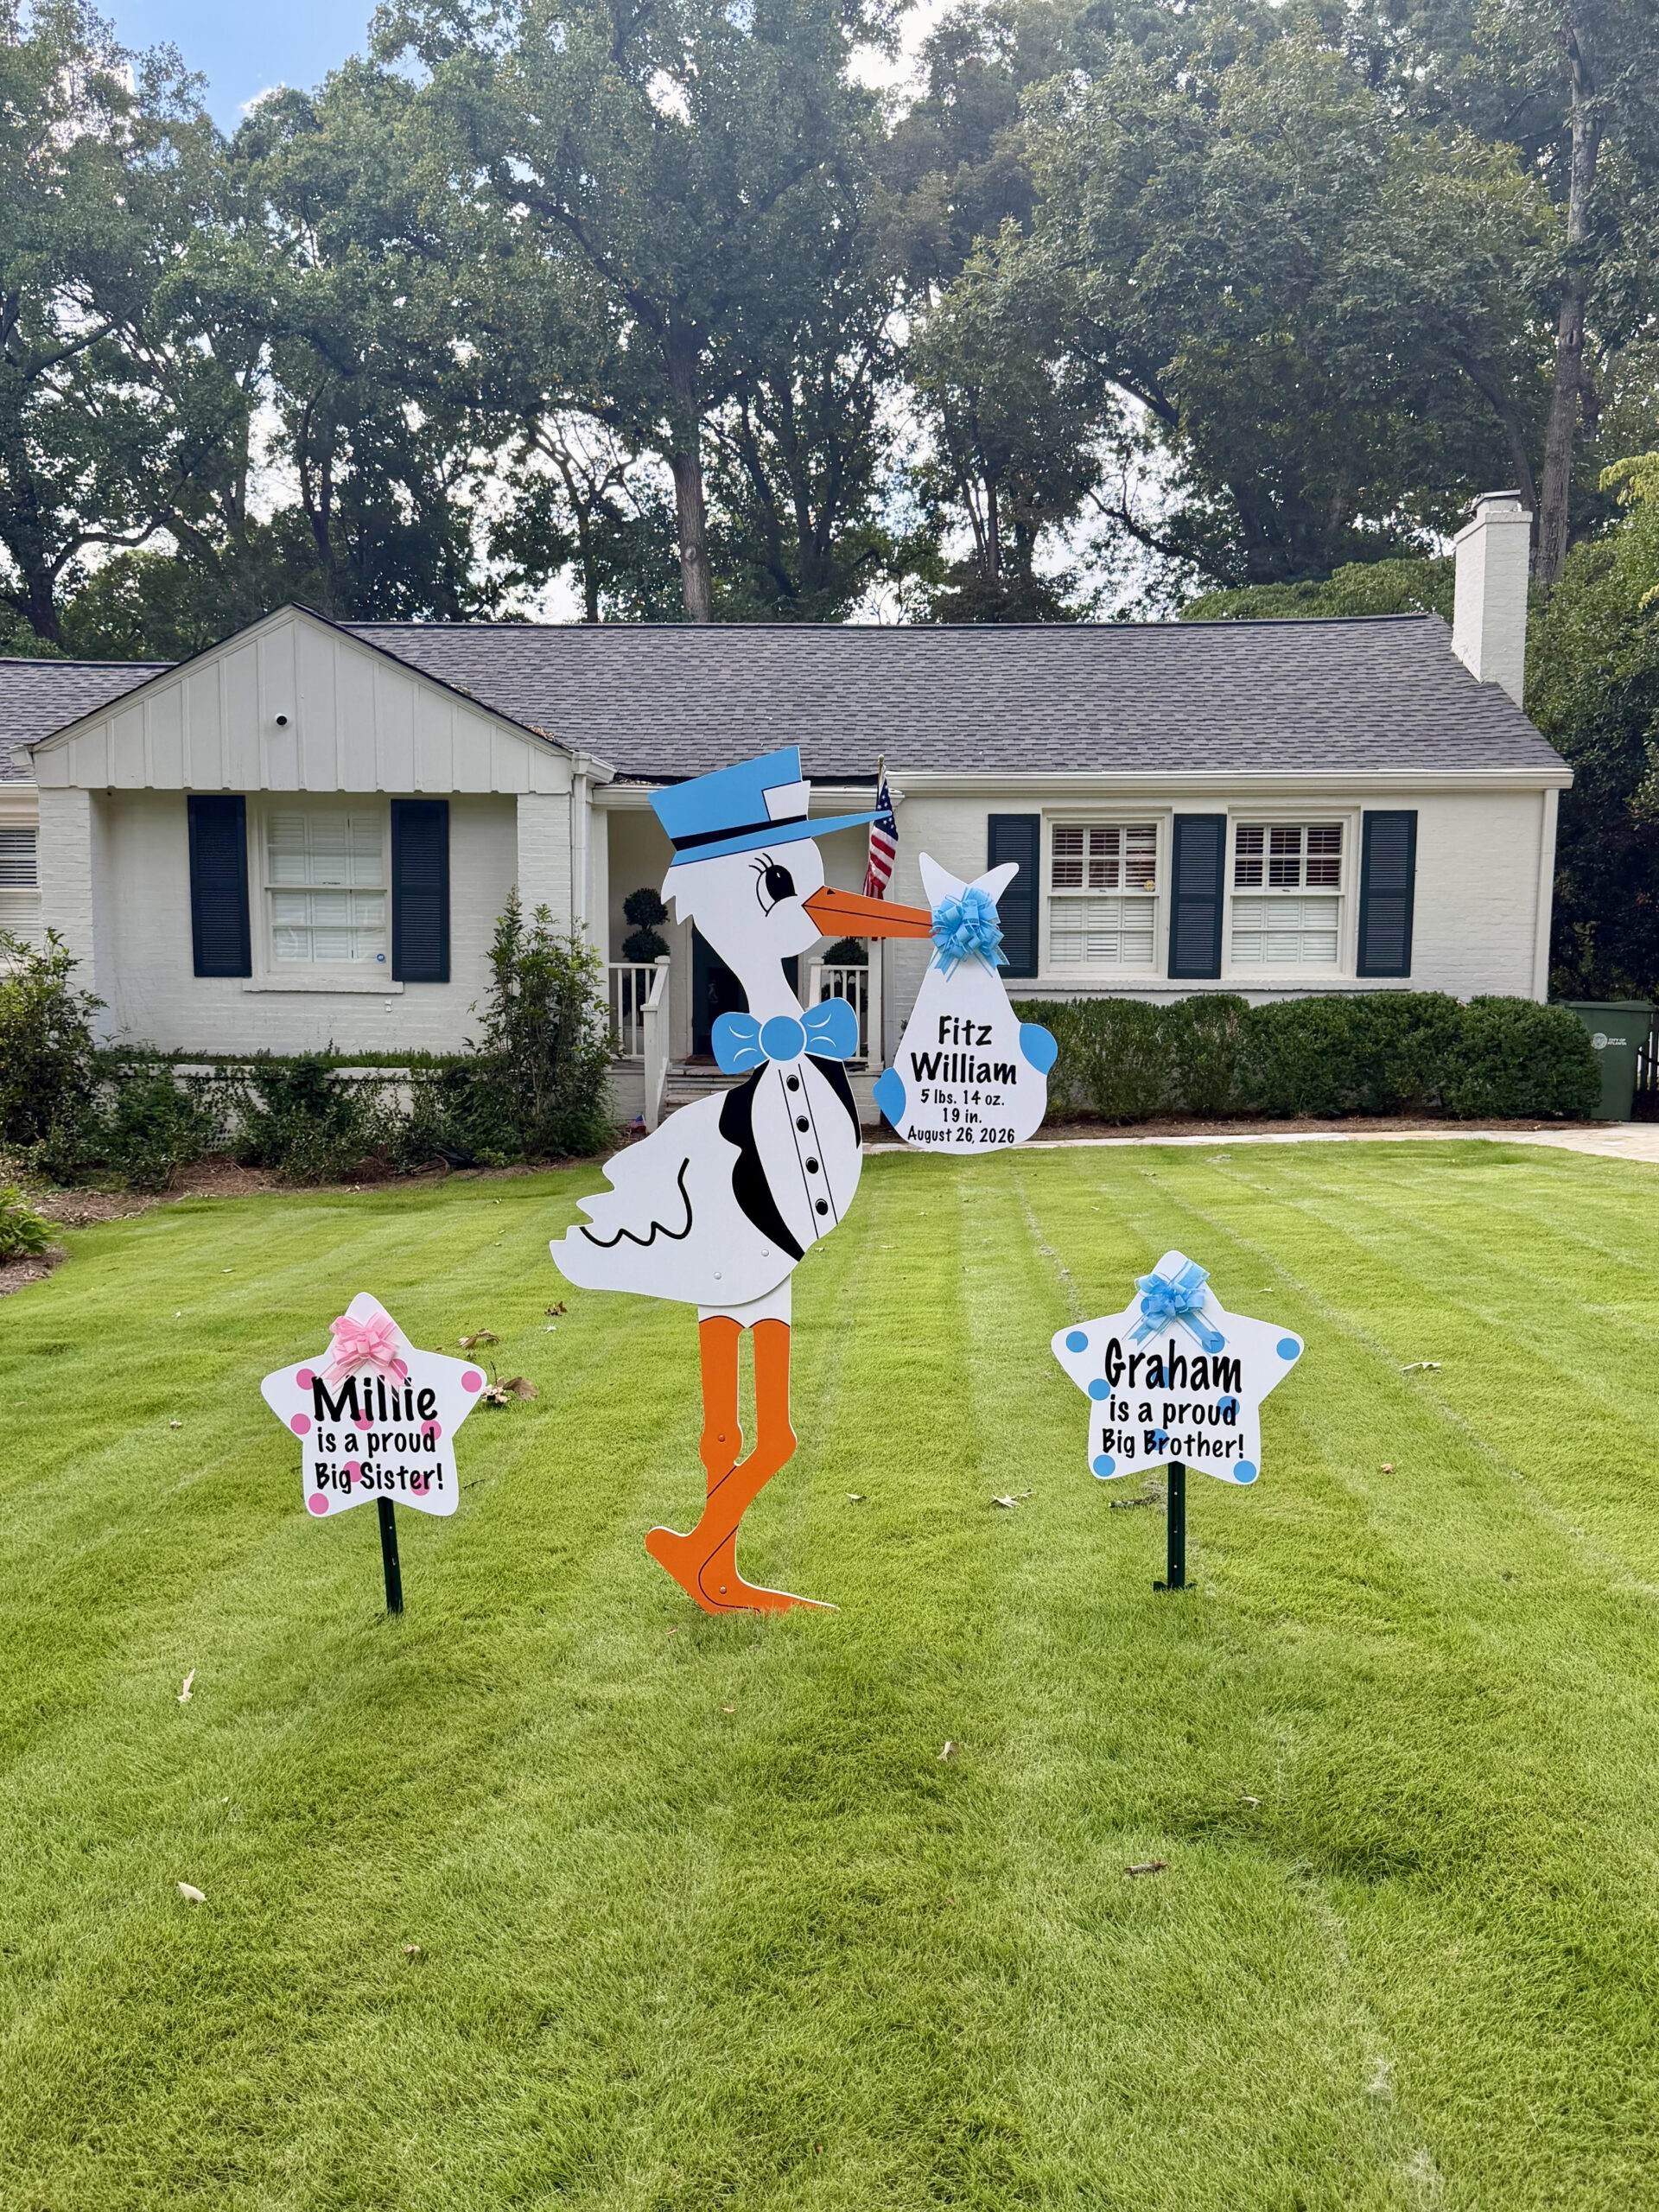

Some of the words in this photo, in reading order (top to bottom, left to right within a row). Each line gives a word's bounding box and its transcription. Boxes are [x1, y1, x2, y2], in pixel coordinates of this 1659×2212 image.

[938, 1014, 993, 1046] Fitz
[910, 1052, 1017, 1085] William
[920, 1088, 931, 1104] 5
[934, 1089, 957, 1104] lbs.
[963, 1090, 982, 1105] 14
[985, 1094, 1005, 1106] oz.
[943, 1107, 960, 1123] 19
[965, 1109, 982, 1124] in.
[907, 1125, 952, 1144] August
[955, 1127, 975, 1144] 26,
[979, 1128, 1015, 1144] 2026
[1104, 1338, 1243, 1394] Graham
[310, 1374, 438, 1421] Millie
[1109, 1394, 1129, 1422] is
[1137, 1402, 1154, 1423] a
[1162, 1398, 1237, 1430] proud
[317, 1426, 337, 1453] is
[344, 1433, 359, 1453] a
[366, 1426, 436, 1459] proud
[1102, 1427, 1135, 1459] Big
[1143, 1429, 1244, 1459] Brother!
[315, 1462, 352, 1495] Big
[359, 1461, 443, 1491] Sister!
